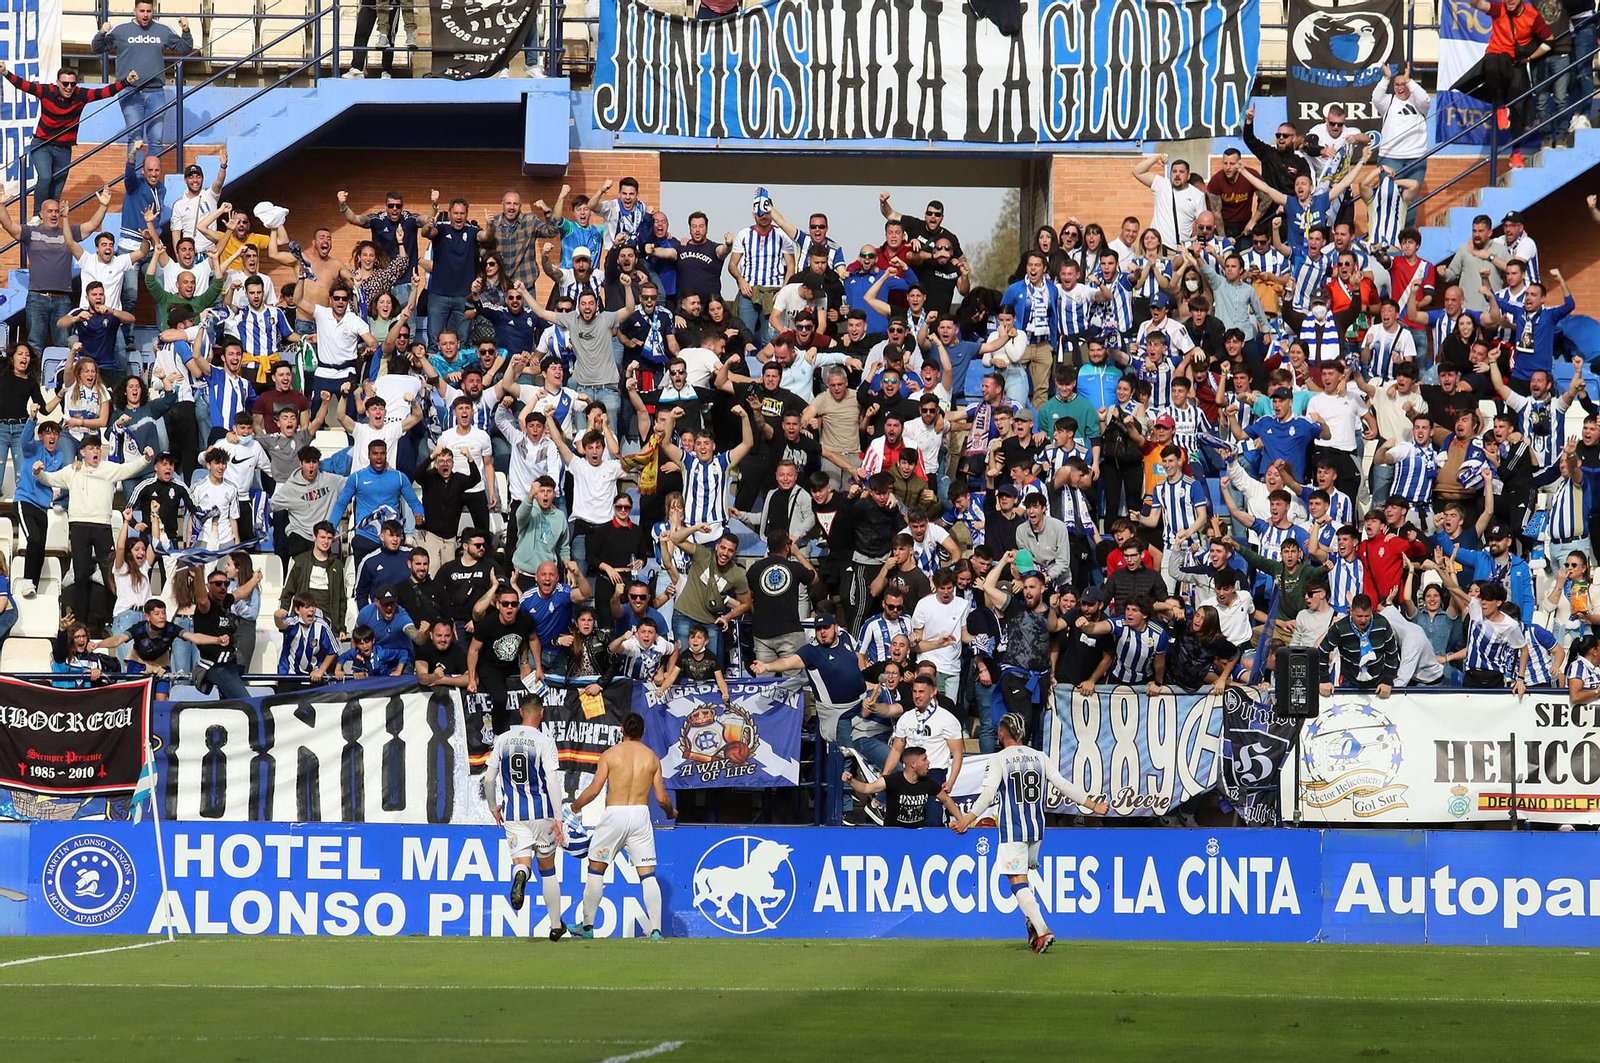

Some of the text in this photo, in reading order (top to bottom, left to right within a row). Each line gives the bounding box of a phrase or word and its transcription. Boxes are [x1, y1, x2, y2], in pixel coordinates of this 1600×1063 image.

[127, 34, 161, 44] adidas
[441, 14, 472, 42] LOCOS
[473, 36, 490, 45] DE
[593, 0, 1248, 142] JUNTOS HACIA LA GLORIA
[1292, 63, 1399, 88] ULTRAS RECE
[731, 684, 801, 710] JOVEN
[510, 737, 535, 747] DELGADO
[509, 752, 530, 785] 9
[680, 759, 730, 778] A WAY
[1434, 732, 1600, 786] HELICÓ
[30, 765, 56, 779] 1985
[68, 765, 95, 779] 2010
[702, 763, 757, 783] OF LIFE
[1010, 769, 1041, 805] 18
[1112, 786, 1171, 811] Recre
[1309, 790, 1336, 803] Sector
[1354, 793, 1398, 812] Gol Sur
[1553, 798, 1581, 810] DEL
[73, 838, 107, 849] ALONSO
[173, 833, 381, 881] HOTEL
[813, 854, 1302, 915] ATRACCIONES LA CINTA
[48, 892, 131, 923] HOTEL APARTAMENTO
[147, 888, 408, 937] ALONSO
